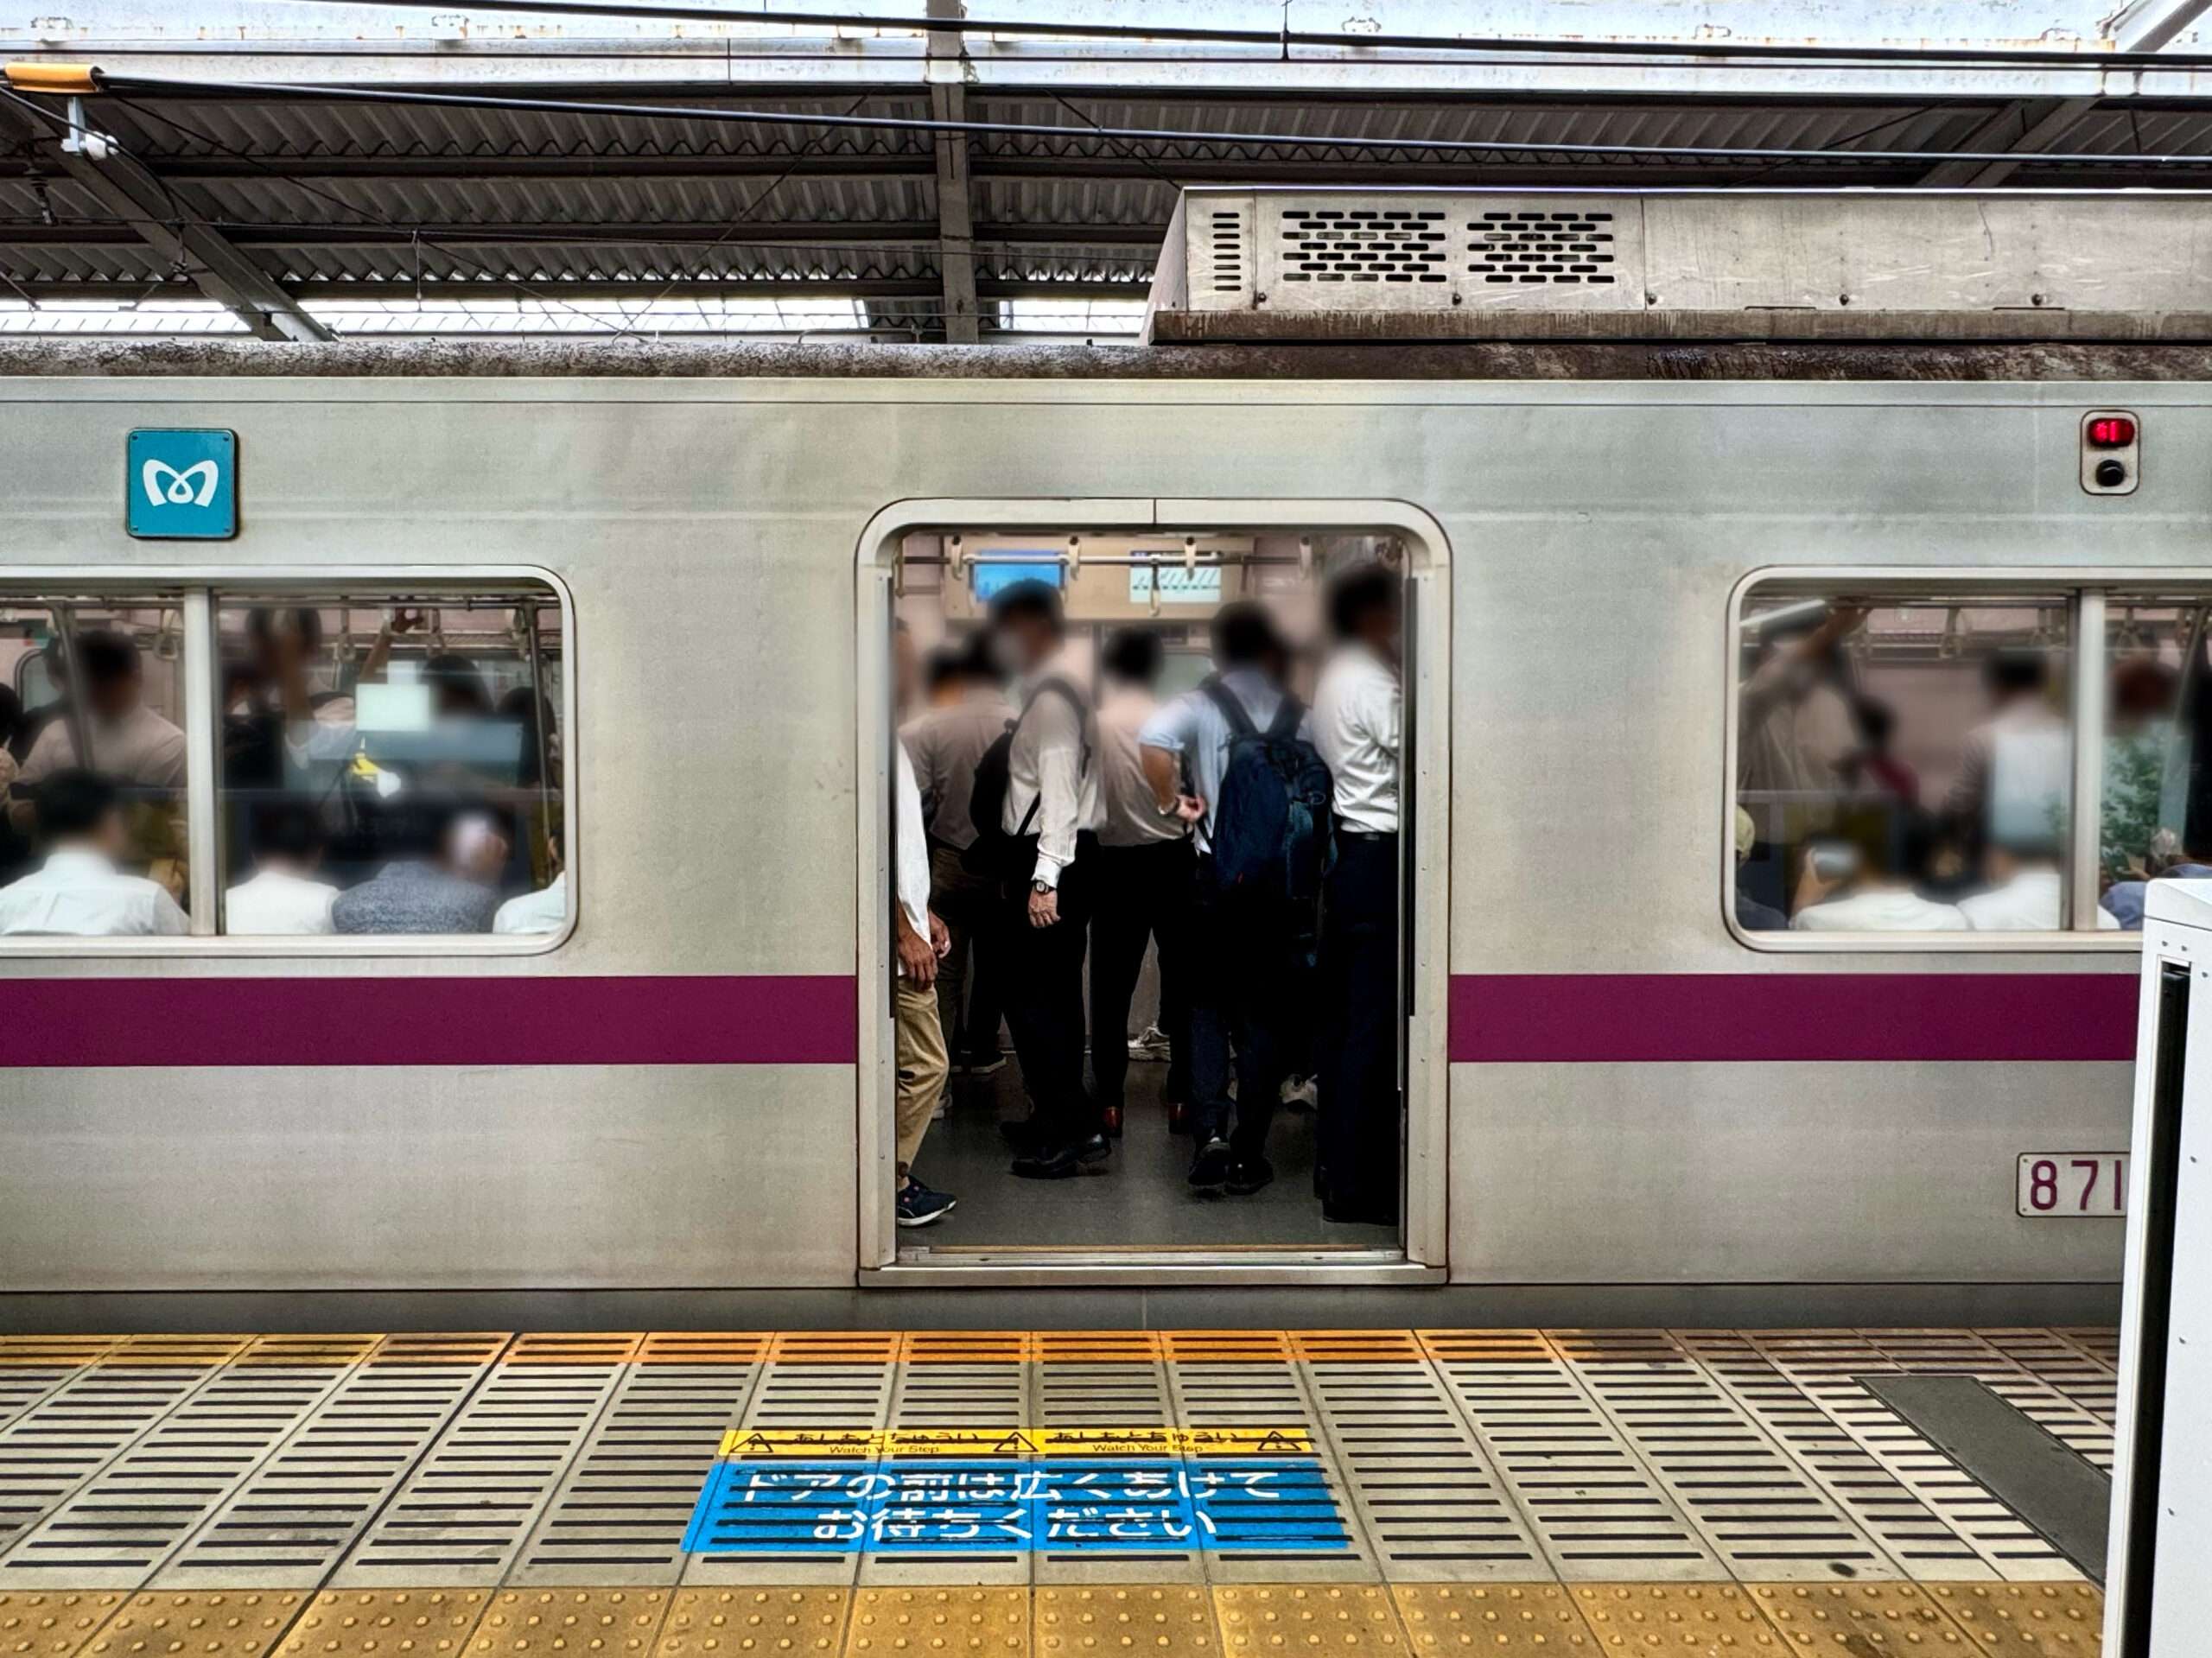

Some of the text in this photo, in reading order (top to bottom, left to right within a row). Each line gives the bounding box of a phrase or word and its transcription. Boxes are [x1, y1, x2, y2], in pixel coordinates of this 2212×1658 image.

[908, 1445, 940, 1454] Step
[1092, 1444, 1204, 1453] Watch Your Step
[743, 1471, 1280, 1502] ドアの前は広くあけて
[813, 1508, 1217, 1541] お待ちください
